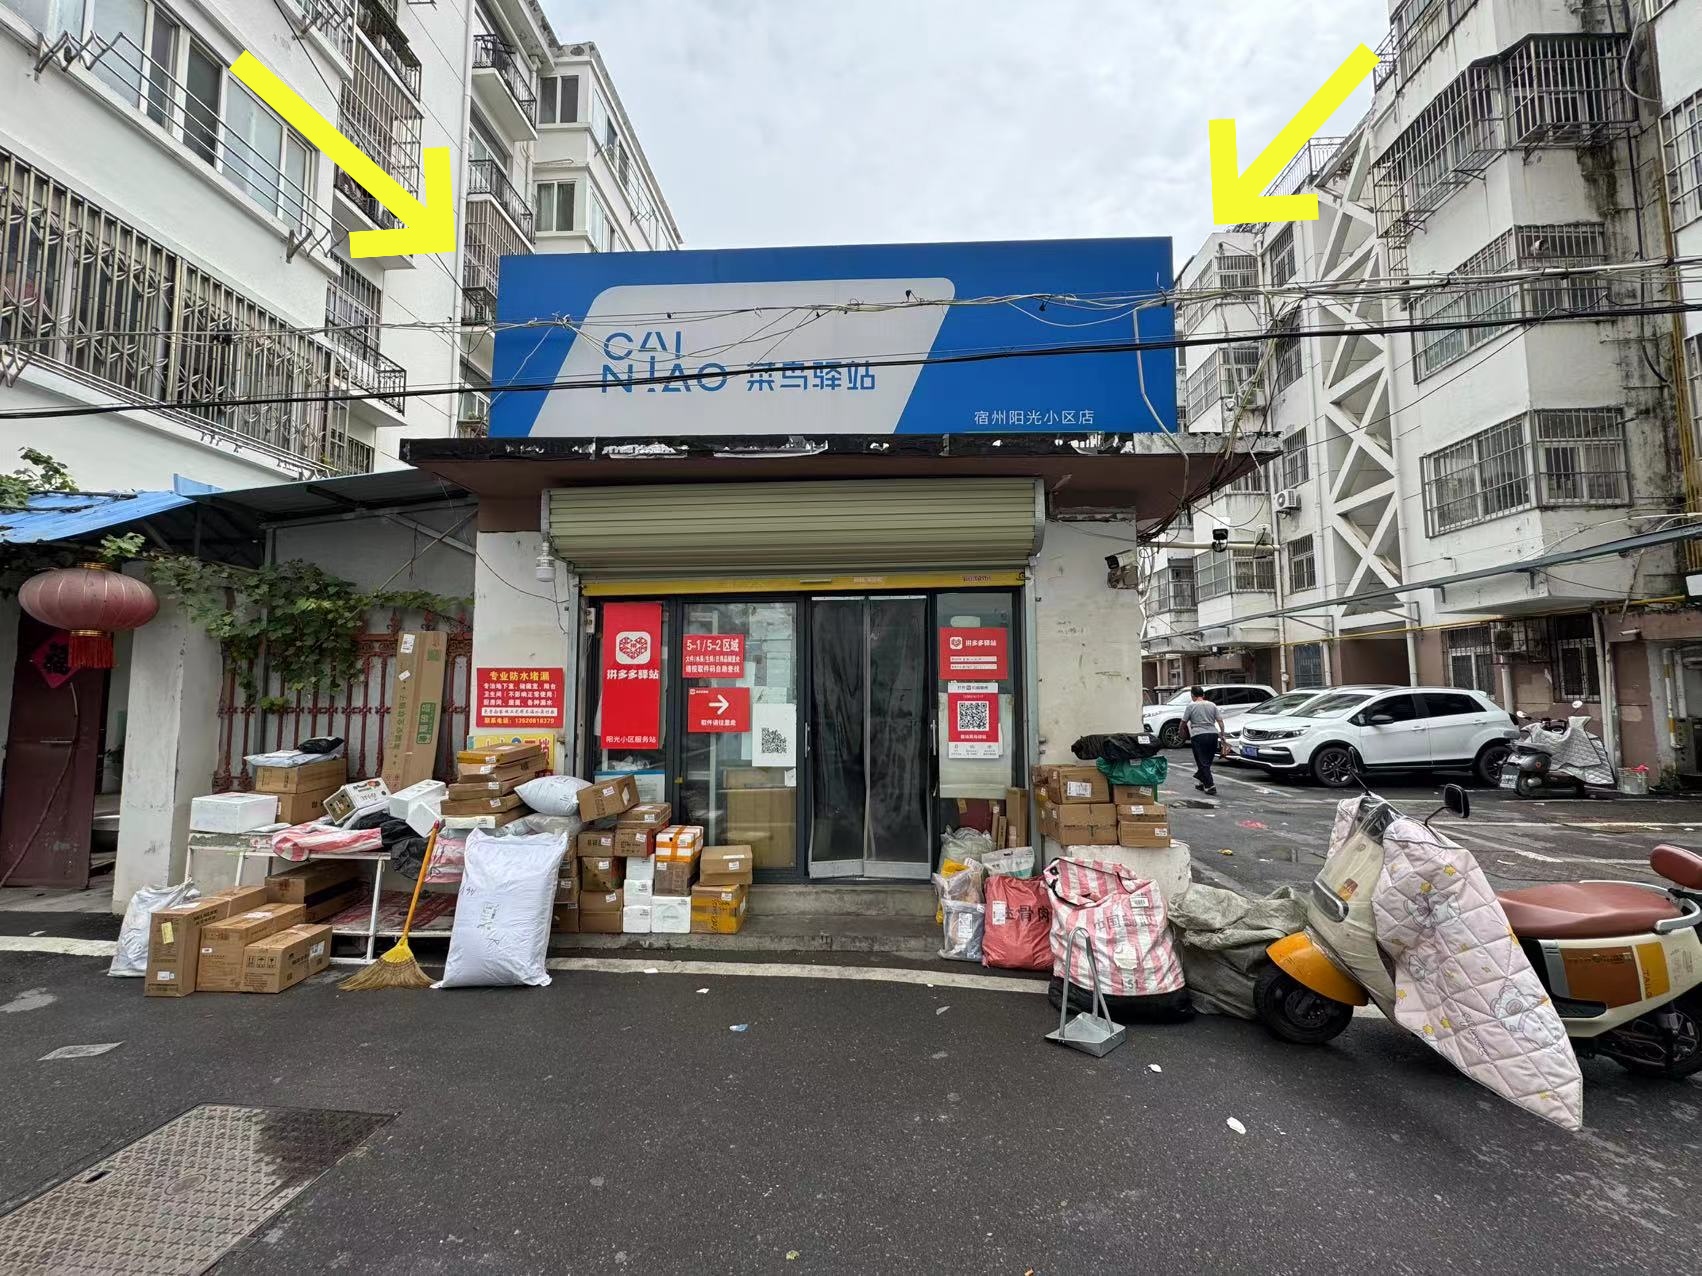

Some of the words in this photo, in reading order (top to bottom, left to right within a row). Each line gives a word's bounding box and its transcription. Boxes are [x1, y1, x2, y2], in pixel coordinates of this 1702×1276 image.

[603, 331, 681, 361] CAI
[601, 355, 728, 393] NIAO
[746, 360, 876, 392] 菜鸟驿站
[974, 410, 1095, 425] 宿州阳光小区店
[489, 671, 550, 681] 专业防水堵漏
[606, 669, 660, 680] 拼多多驿站
[605, 735, 657, 744] 阳光小区服务站
